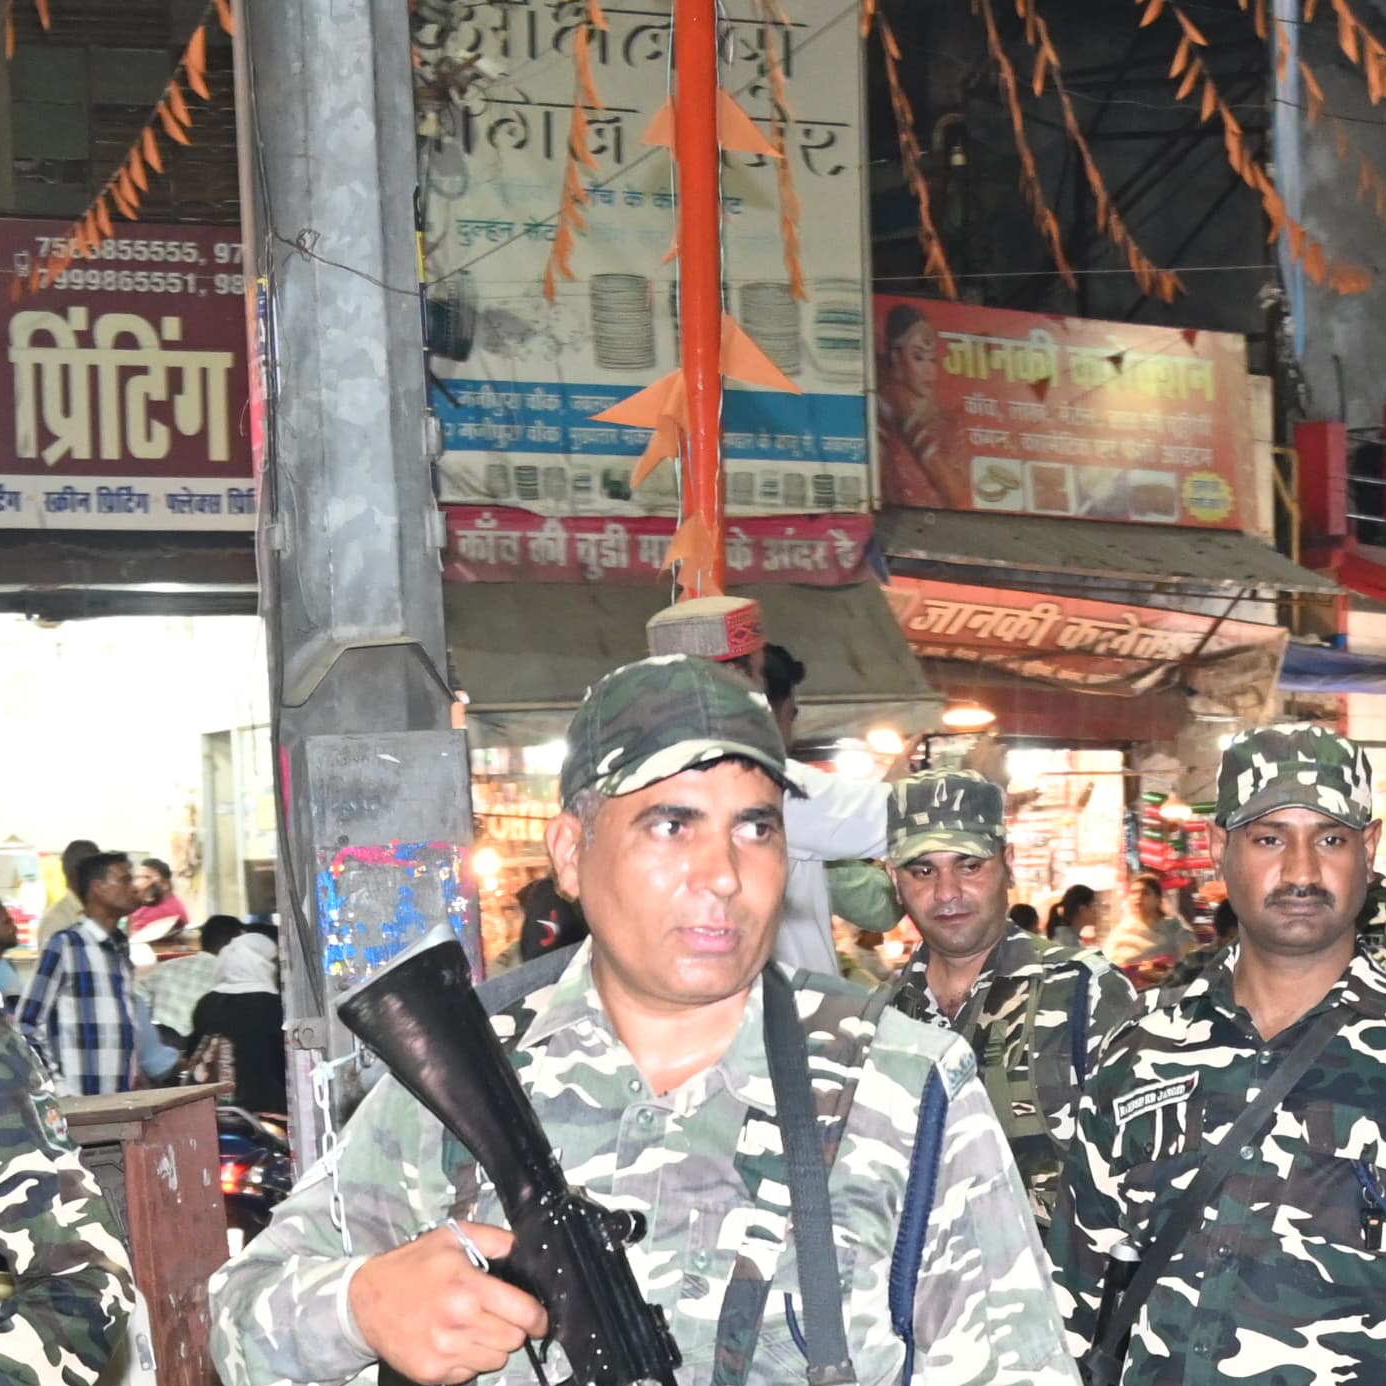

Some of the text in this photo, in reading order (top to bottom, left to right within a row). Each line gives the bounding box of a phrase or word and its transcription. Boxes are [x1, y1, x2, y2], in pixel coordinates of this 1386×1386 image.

[937, 328, 1062, 388] जानकी
[8, 306, 234, 467] प्रिंटिंग
[527, 518, 569, 567] की
[908, 598, 1064, 647] जानकी
